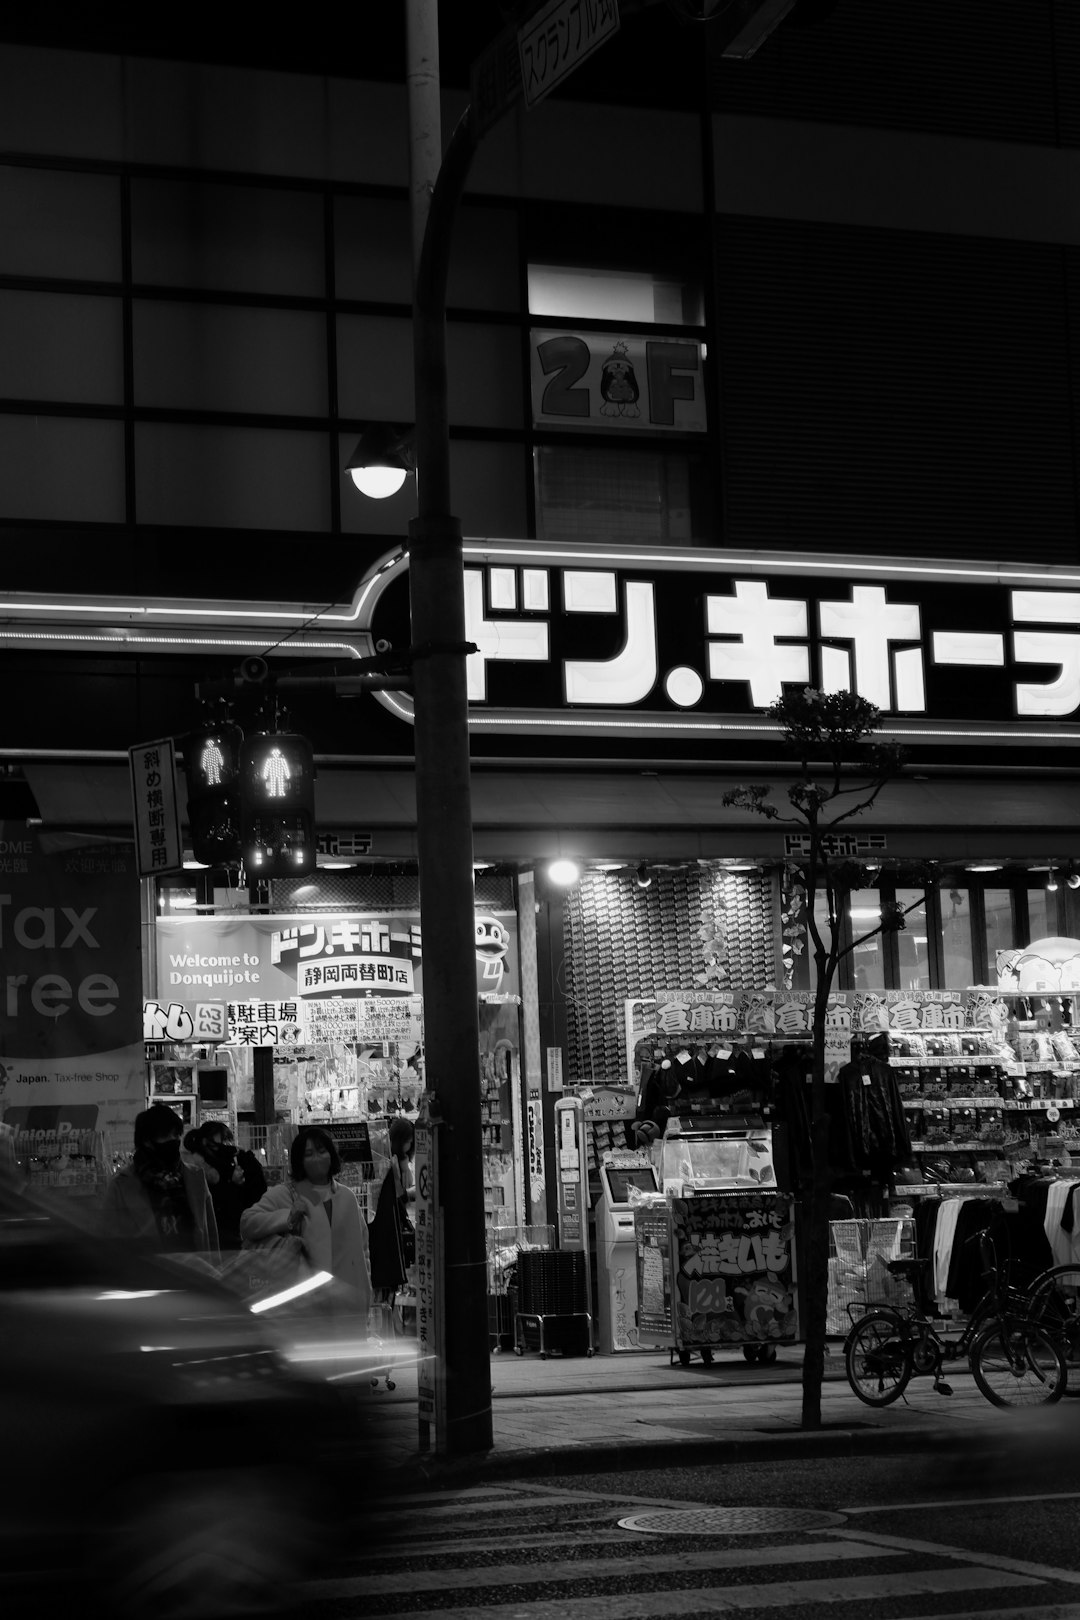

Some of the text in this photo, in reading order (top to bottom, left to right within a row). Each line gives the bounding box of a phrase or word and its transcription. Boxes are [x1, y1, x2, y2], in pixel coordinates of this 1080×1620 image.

[143, 750, 168, 867] 斜め横断専用
[169, 953, 260, 968] Welcome to
[169, 971, 260, 987] Donquijote
[304, 962, 409, 988] 静岡両替町店
[656, 1000, 738, 1033] 倉庫市
[775, 1001, 852, 1033] 倉市
[889, 999, 966, 1030] 倉庫市
[54, 1073, 93, 1083] Tax-free
[95, 1072, 120, 1083] Shop
